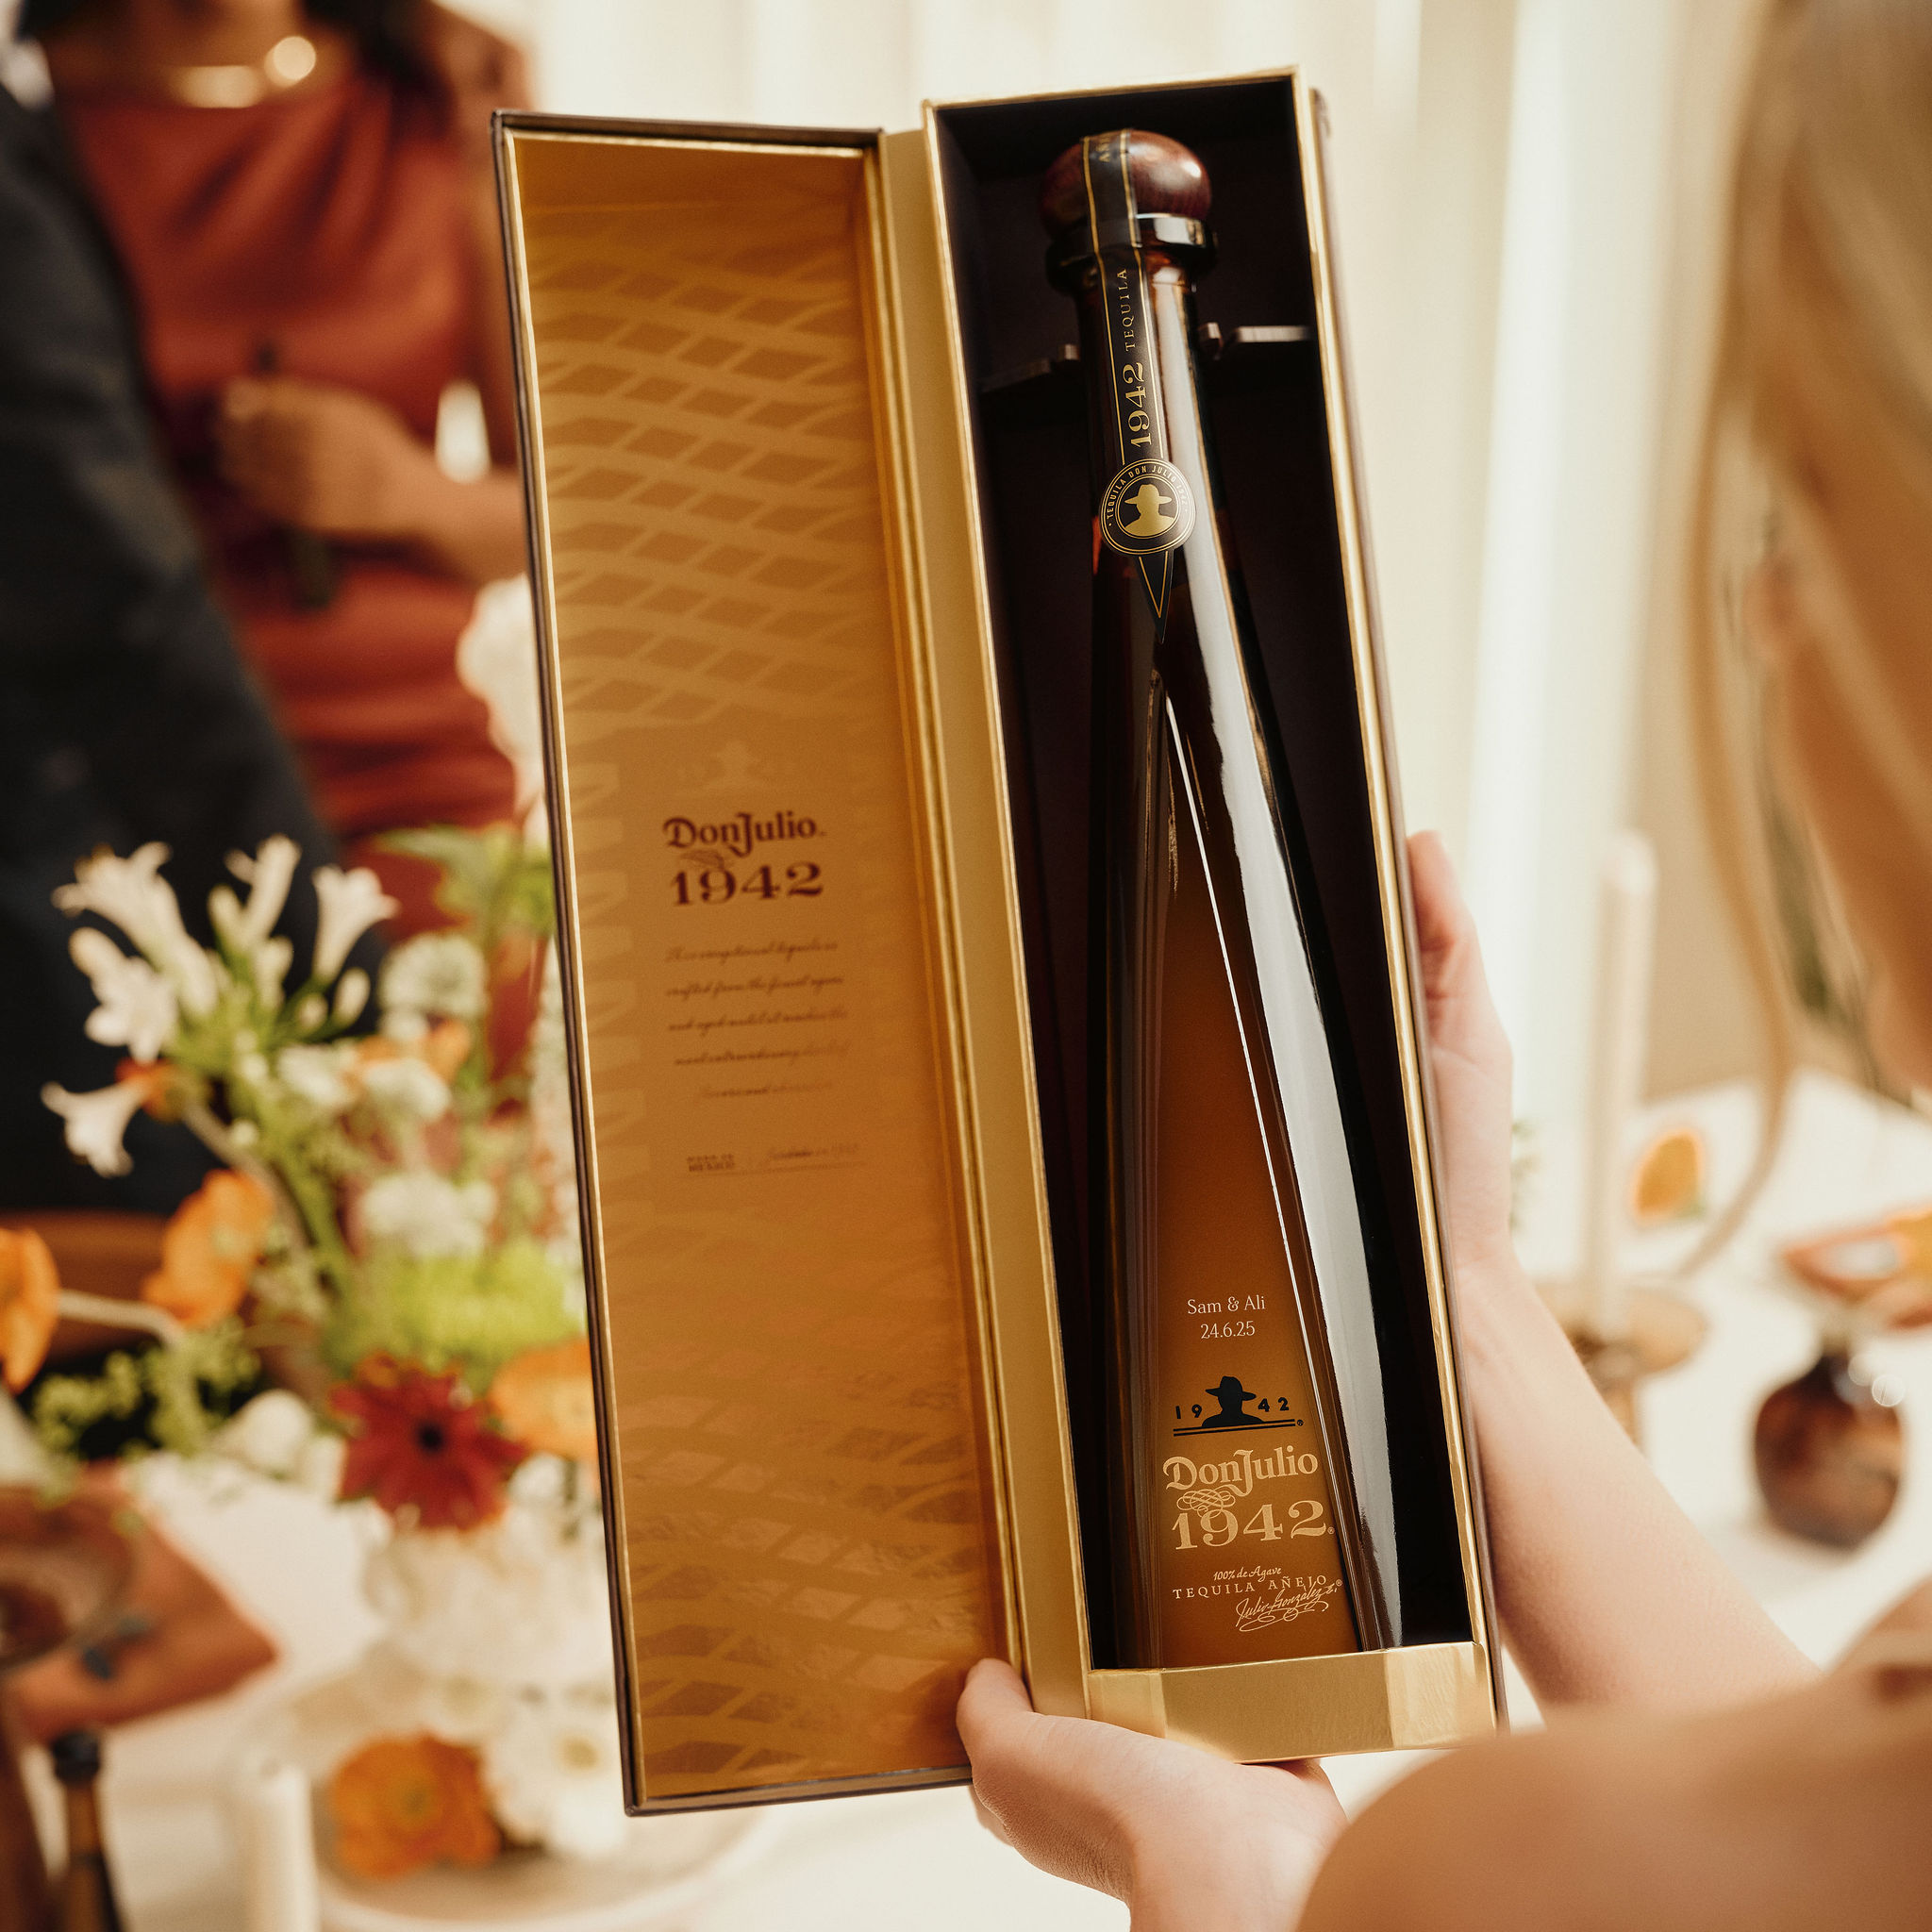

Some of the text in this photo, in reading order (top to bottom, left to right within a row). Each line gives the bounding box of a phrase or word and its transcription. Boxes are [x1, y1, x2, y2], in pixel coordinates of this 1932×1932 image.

[1117, 269, 1152, 448] 1942 TEQUILA
[1107, 478, 1126, 520] TEQUILA
[1128, 465, 1147, 478] DON
[1152, 465, 1176, 483] JULIO
[671, 860, 824, 907] 1942
[1187, 1294, 1267, 1315] Sam & Ali
[1200, 1321, 1257, 1340] 24.6.25
[1172, 1500, 1327, 1551] 1942
[1172, 1574, 1327, 1600] TEQUILA AÑEJO
[1213, 1565, 1282, 1583] 100% de Agave
